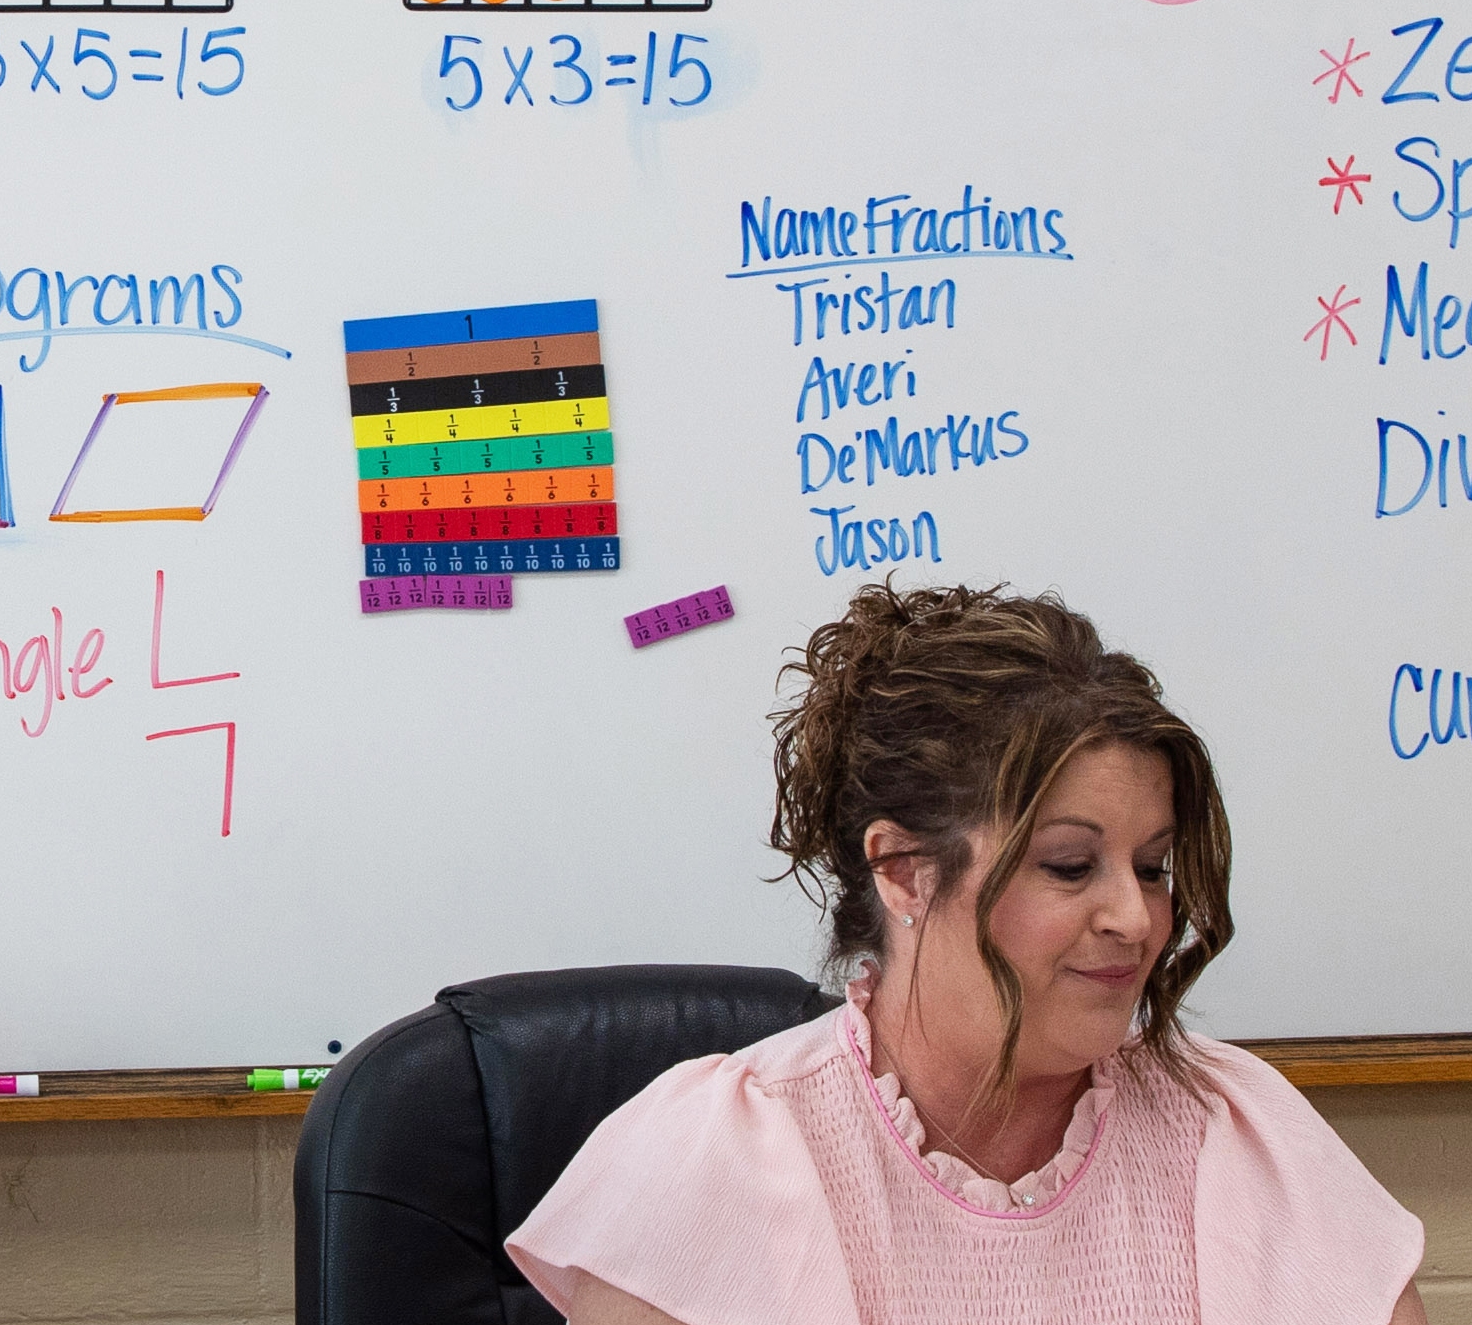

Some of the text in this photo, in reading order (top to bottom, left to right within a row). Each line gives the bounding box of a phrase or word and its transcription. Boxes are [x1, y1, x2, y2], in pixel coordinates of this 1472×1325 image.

[776, 272, 955, 346] Tristan
[796, 349, 916, 423] Averi
[810, 505, 941, 576] Jason
